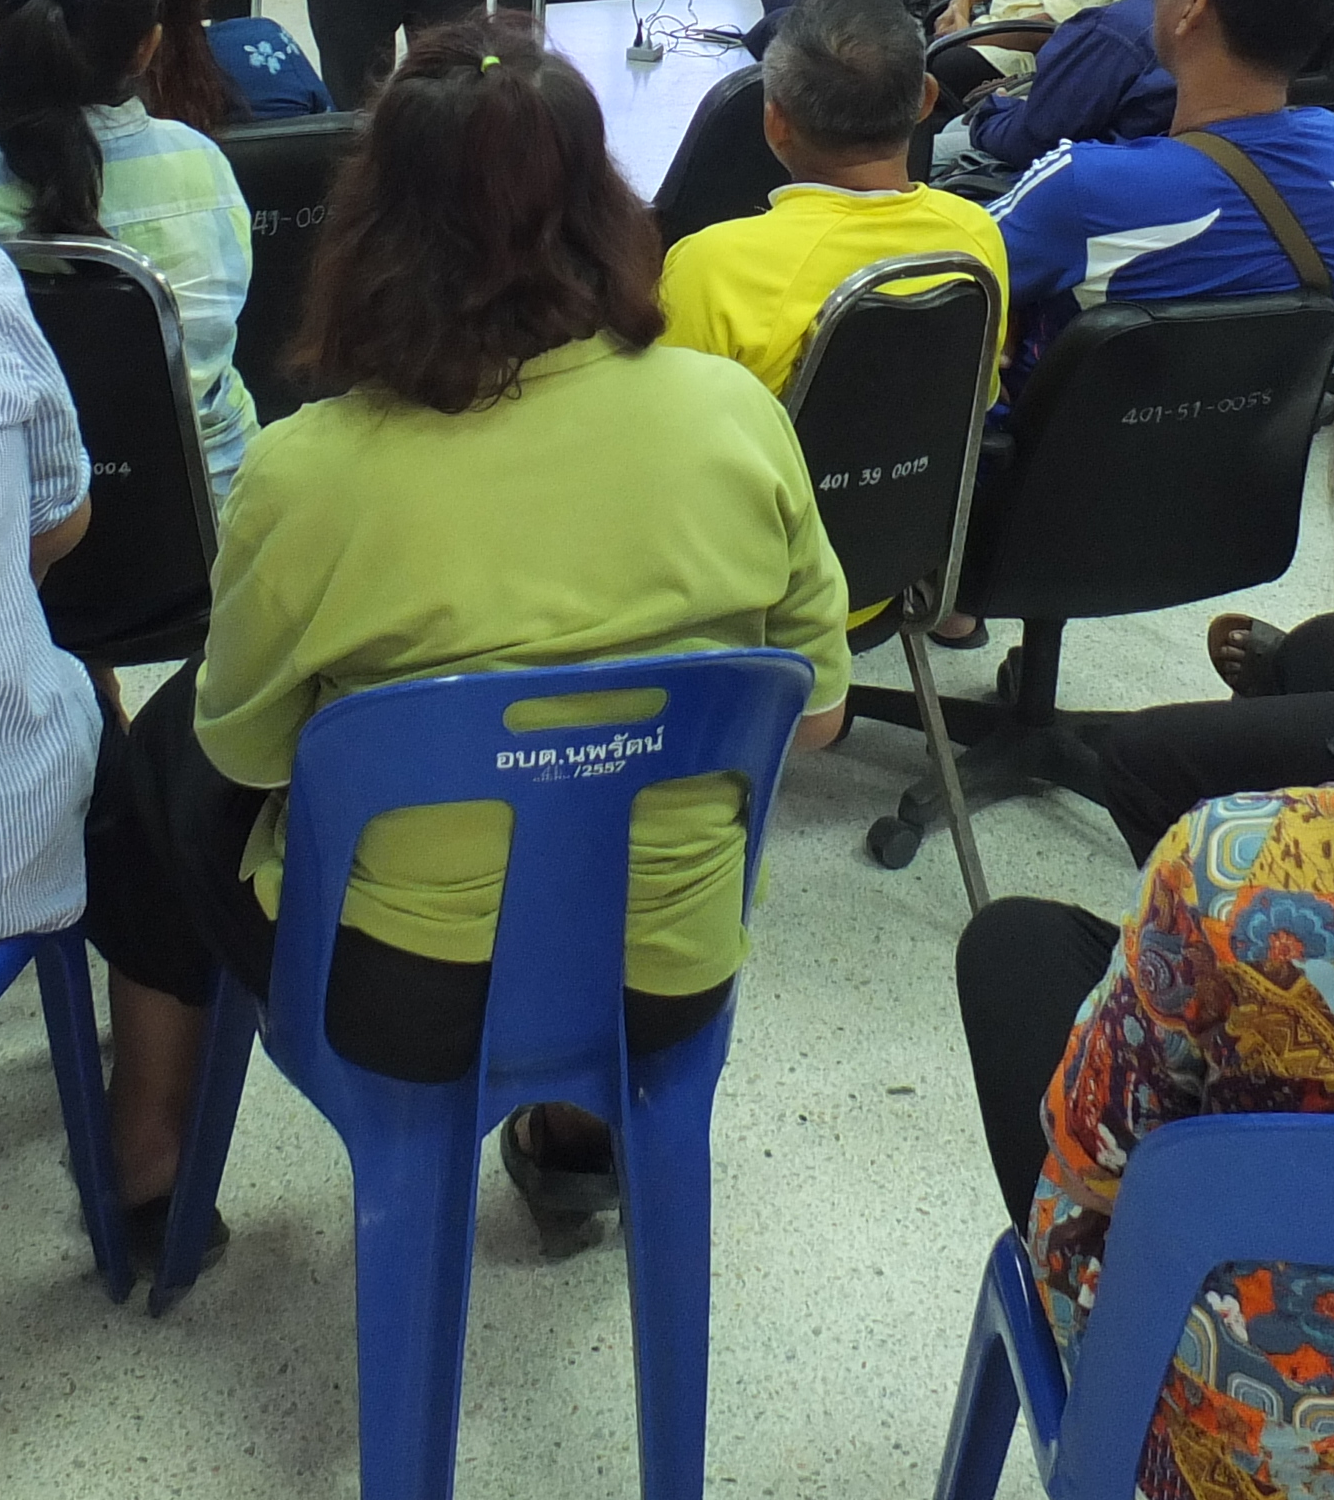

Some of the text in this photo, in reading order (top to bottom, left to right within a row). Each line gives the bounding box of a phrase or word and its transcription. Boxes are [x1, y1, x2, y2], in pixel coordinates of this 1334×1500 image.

[819, 456, 928, 491] 401 39 0015
[496, 725, 665, 769] อบต.นพรัตน์
